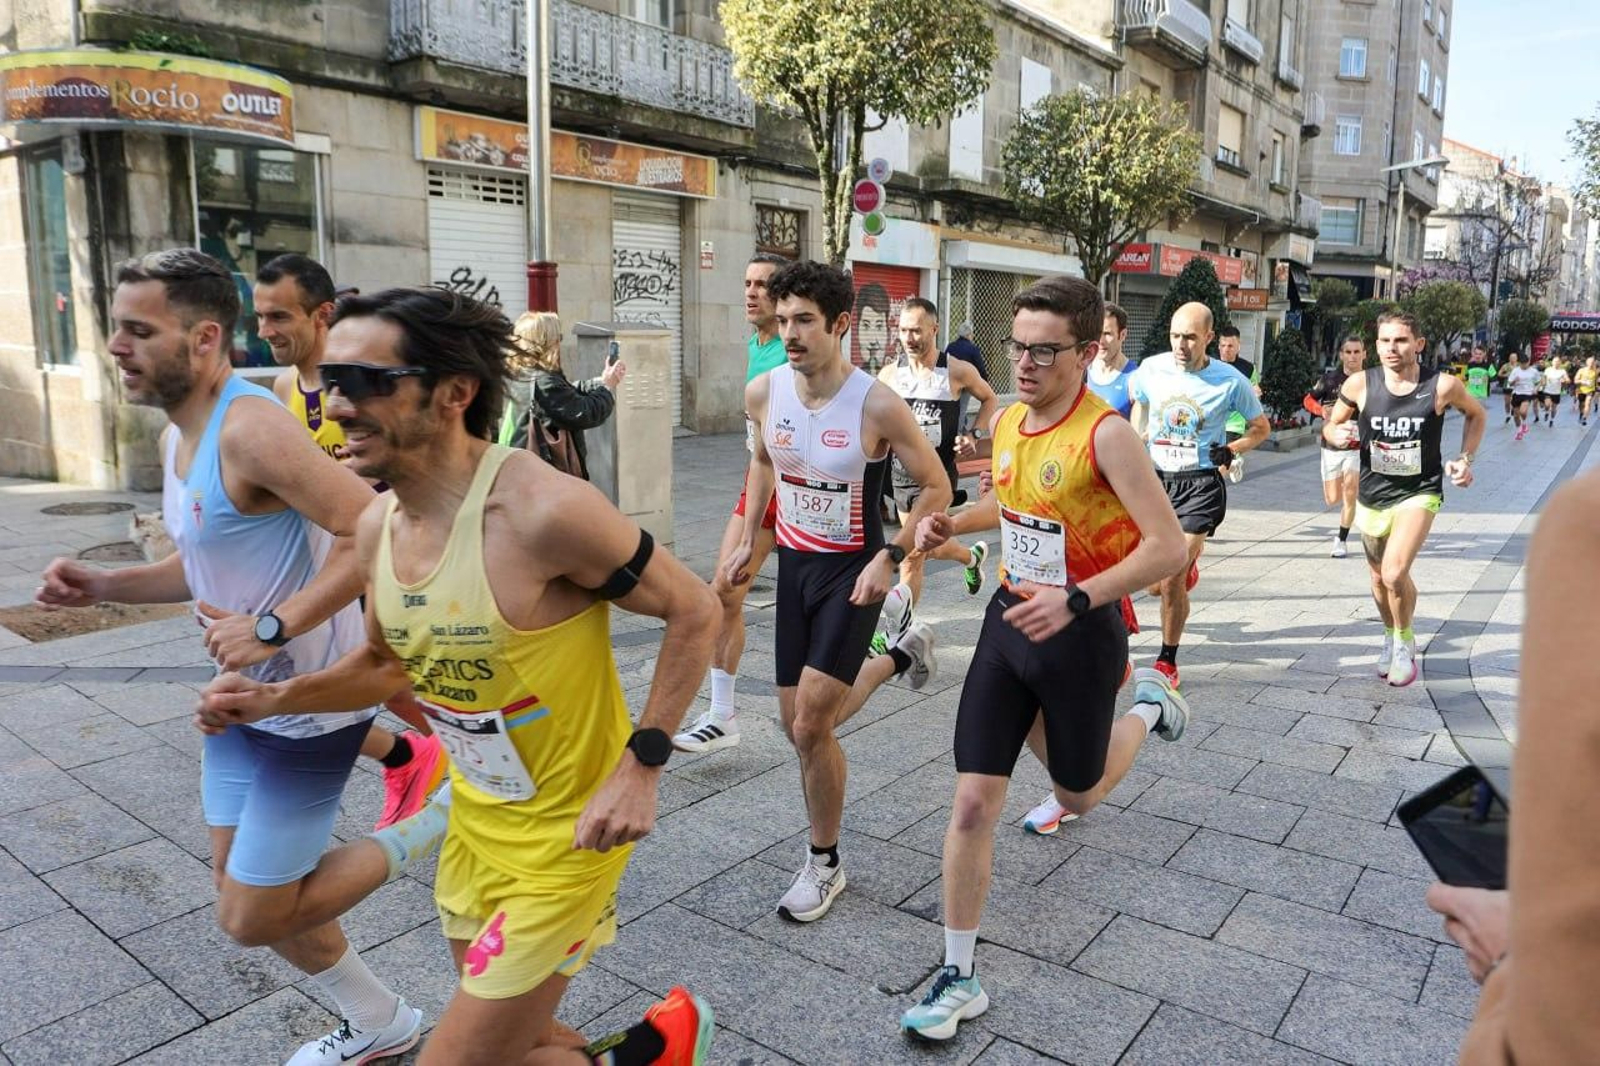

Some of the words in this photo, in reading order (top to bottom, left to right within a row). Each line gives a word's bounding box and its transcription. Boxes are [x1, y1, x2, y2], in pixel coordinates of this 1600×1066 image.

[221, 92, 282, 116] OUTLET
[1370, 416, 1425, 431] CLOT
[1382, 430, 1410, 438] TEAM
[793, 491, 833, 513] 1587
[1010, 530, 1041, 557] 352
